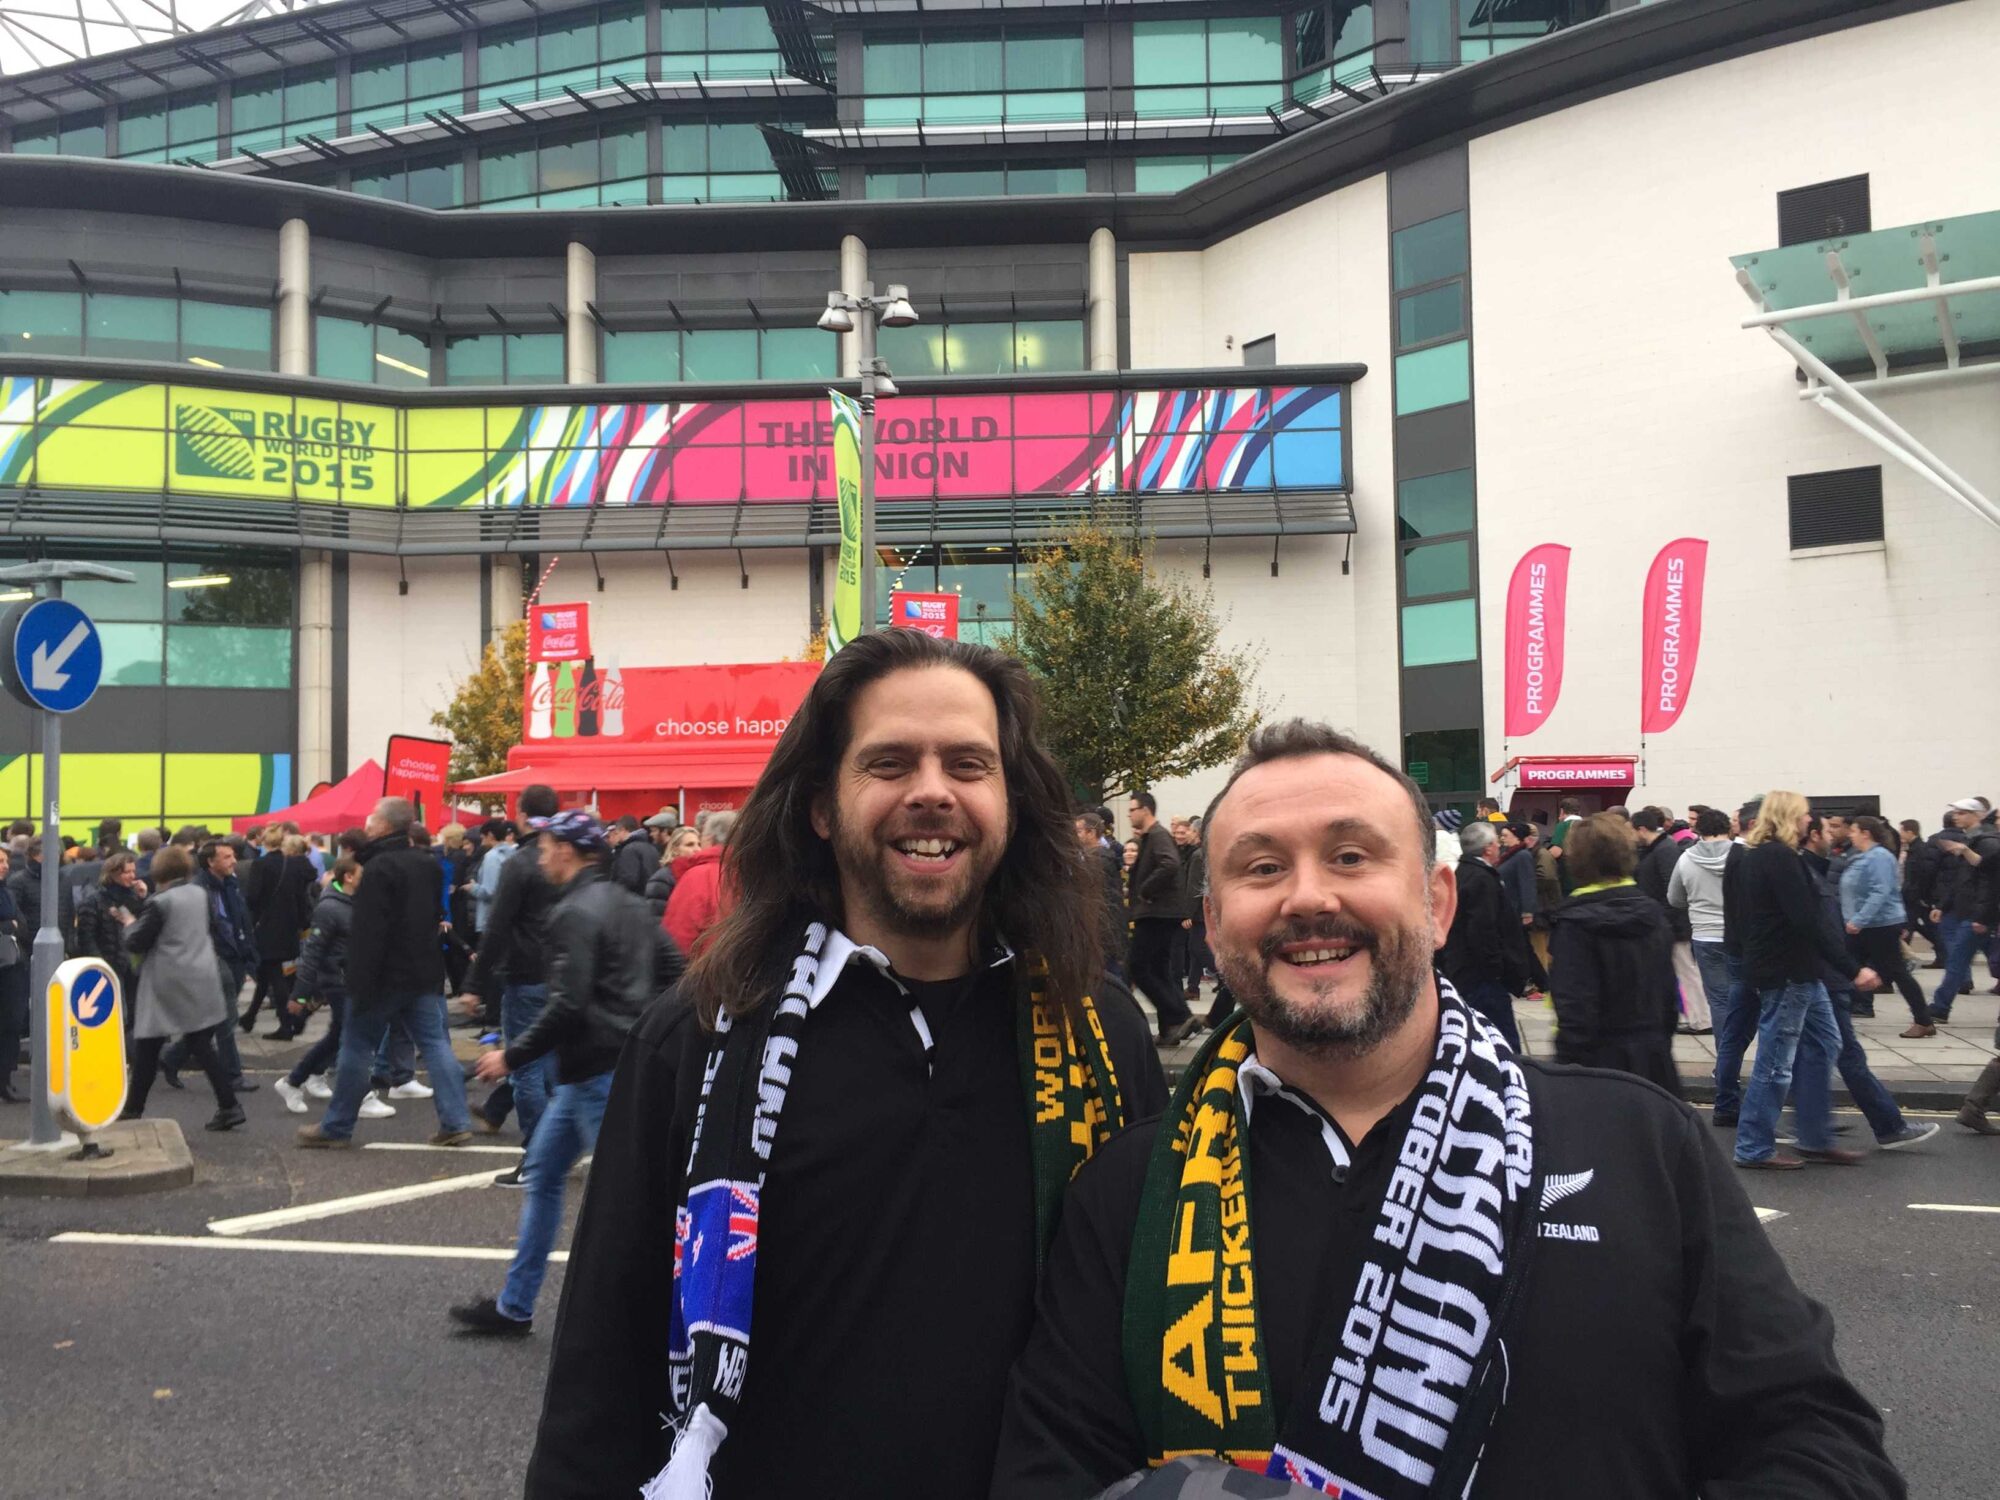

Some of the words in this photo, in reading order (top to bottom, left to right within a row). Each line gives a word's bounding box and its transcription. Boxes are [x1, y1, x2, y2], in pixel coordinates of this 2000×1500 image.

[263, 411, 376, 448] RUGBY
[264, 439, 333, 458] WORLD
[340, 446, 375, 461] CUP
[263, 457, 374, 490] 2015
[788, 454, 828, 482] IN
[874, 451, 969, 480] NION
[922, 612, 946, 620] 2015
[1526, 562, 1547, 714] PROGRAMMES
[1660, 557, 1684, 712] PROGRAMMES
[656, 718, 730, 736] choose
[735, 715, 793, 737] happ
[391, 765, 440, 783] happiness
[400, 757, 437, 772] choose
[1527, 769, 1627, 780] PROGRAMMES
[1373, 1009, 1468, 1250] OCTOBER
[1501, 1060, 1534, 1202] FINAL
[1542, 1222, 1600, 1242] ZEALAND
[1319, 1261, 1396, 1433] 2015
